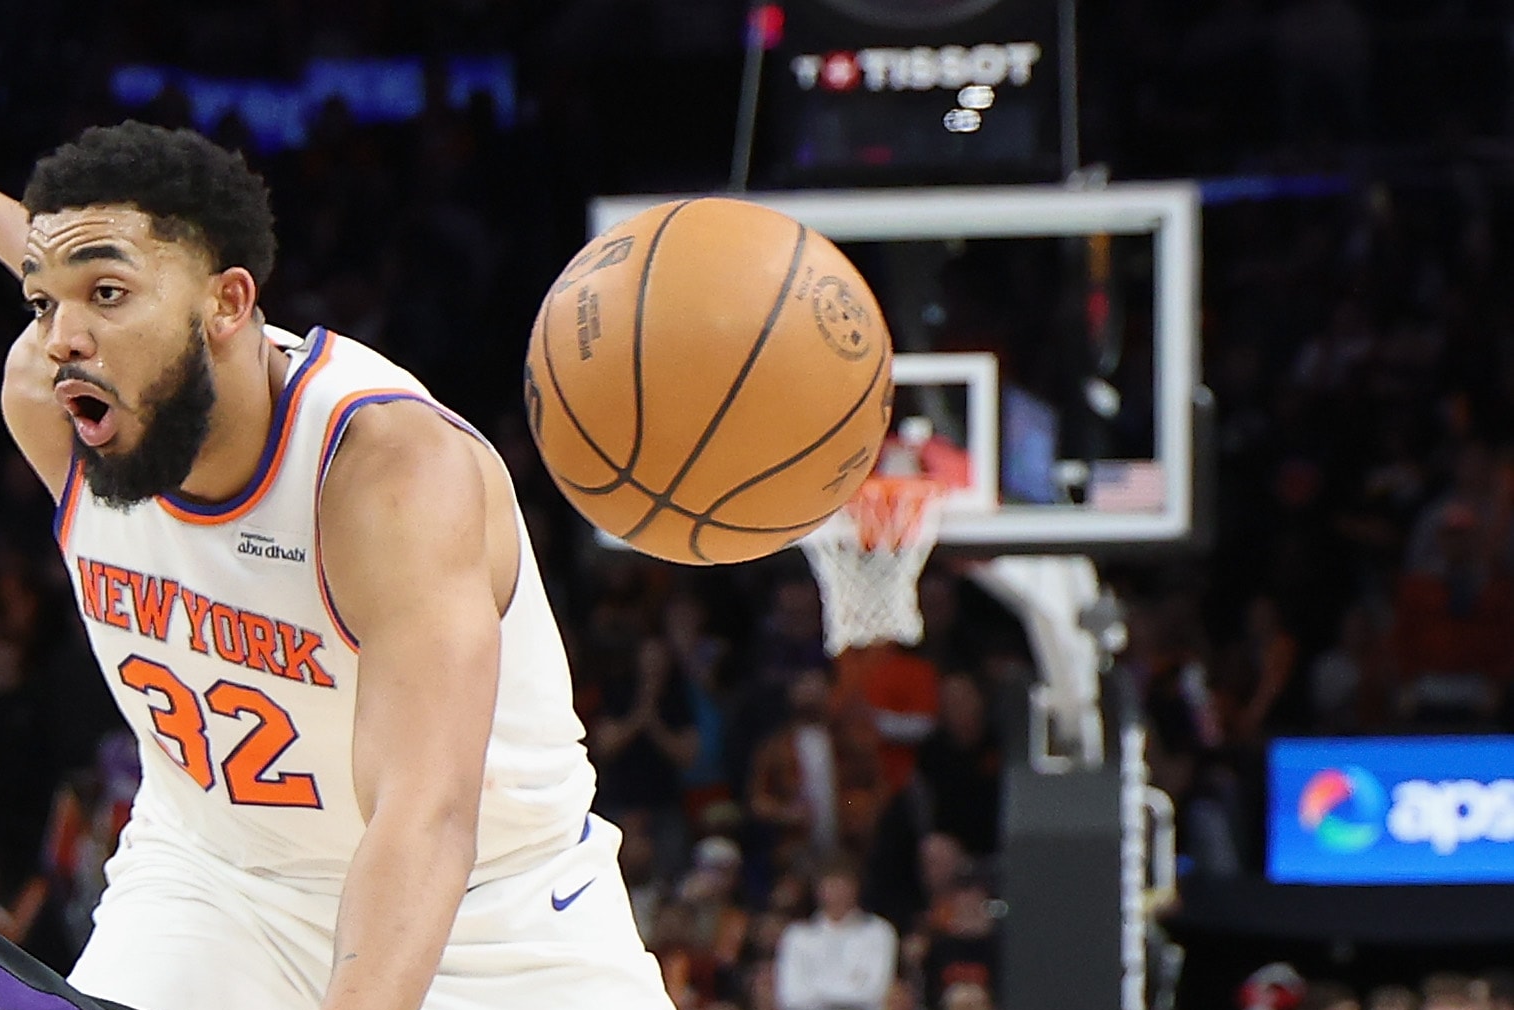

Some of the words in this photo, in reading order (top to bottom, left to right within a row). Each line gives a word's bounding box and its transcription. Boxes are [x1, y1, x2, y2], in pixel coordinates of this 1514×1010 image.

[237, 539, 263, 556] abu
[265, 545, 307, 562] dhabi
[77, 556, 179, 643] NEW
[181, 586, 337, 690] YORK
[117, 653, 324, 810] 32
